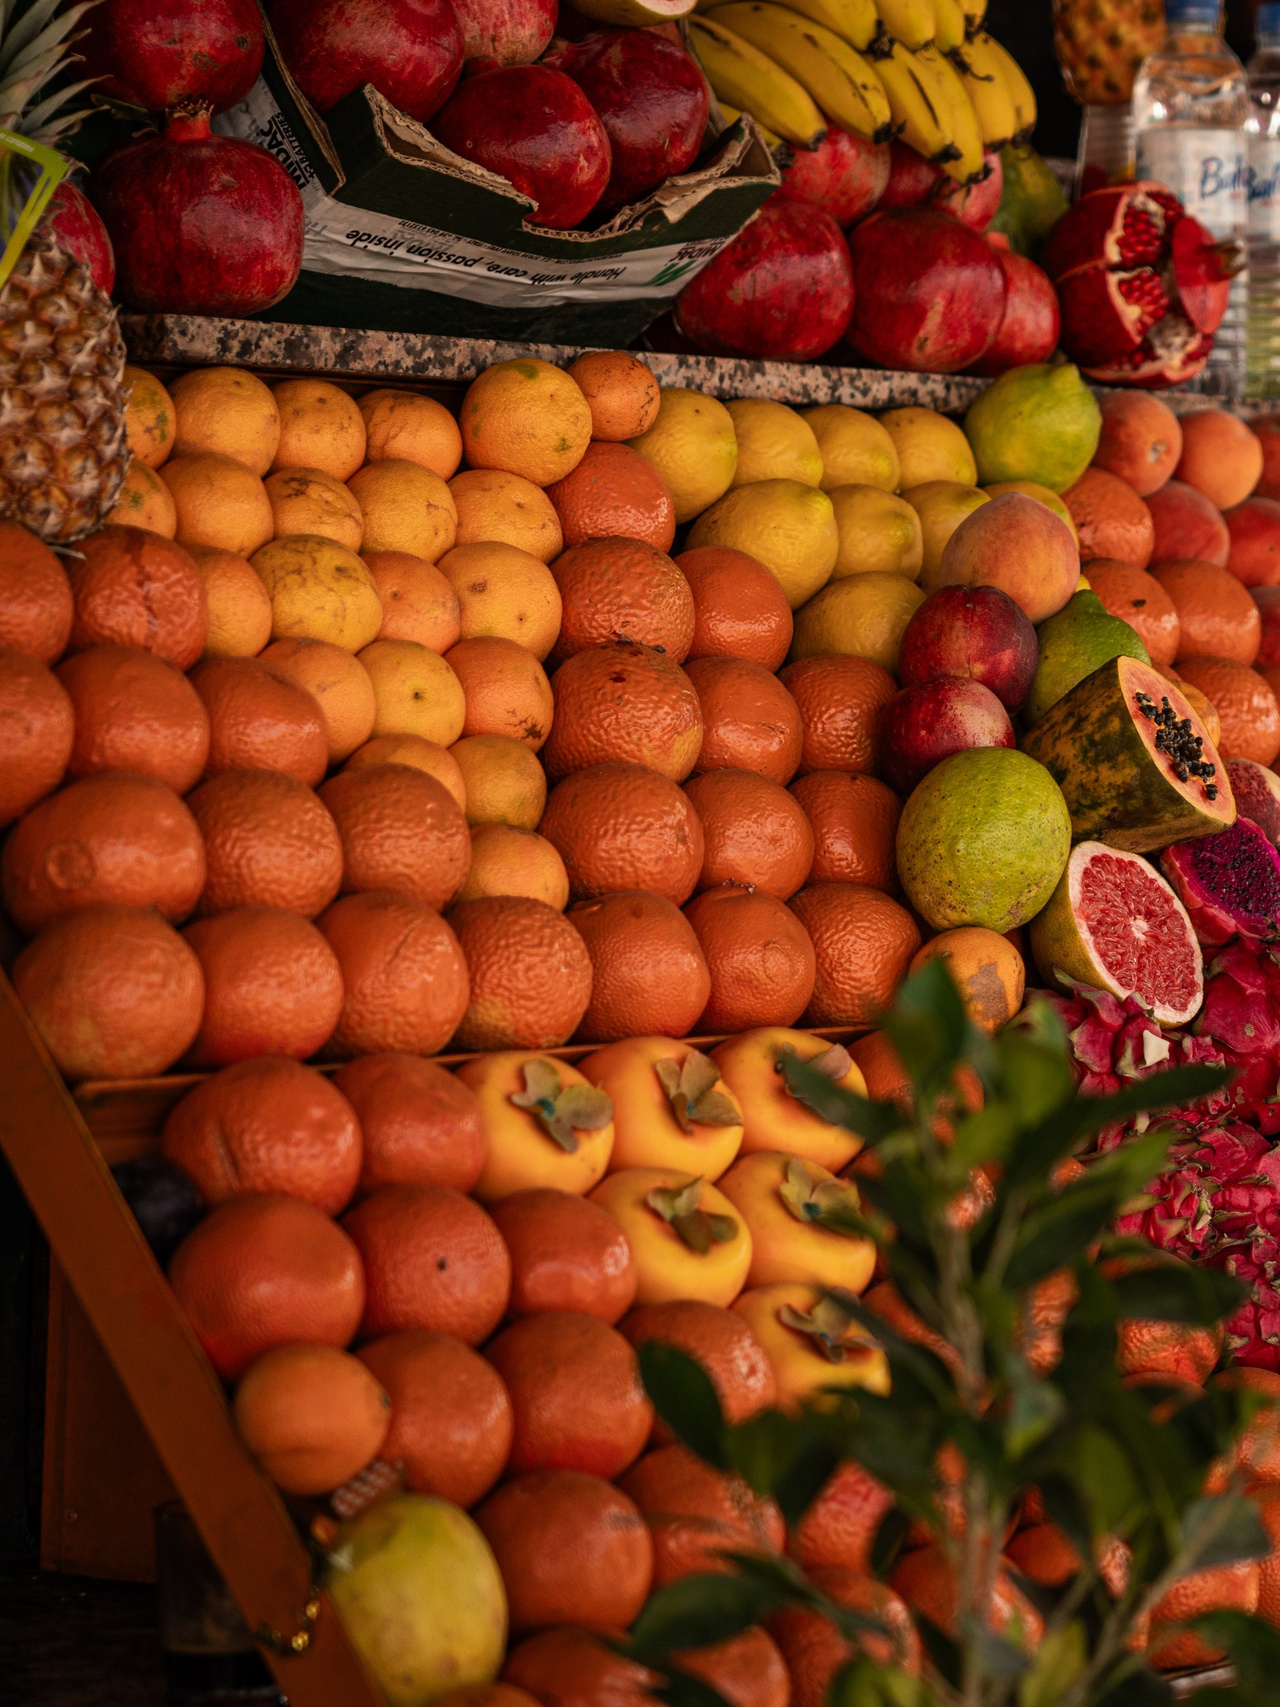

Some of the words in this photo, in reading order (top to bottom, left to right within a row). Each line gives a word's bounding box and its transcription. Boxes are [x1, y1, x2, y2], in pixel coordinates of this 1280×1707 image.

[260, 118, 307, 190] MIDAC
[345, 230, 404, 256] inside
[405, 244, 484, 268] passion
[485, 260, 528, 277] care,
[569, 266, 627, 285] Handle
[530, 273, 567, 286] with
